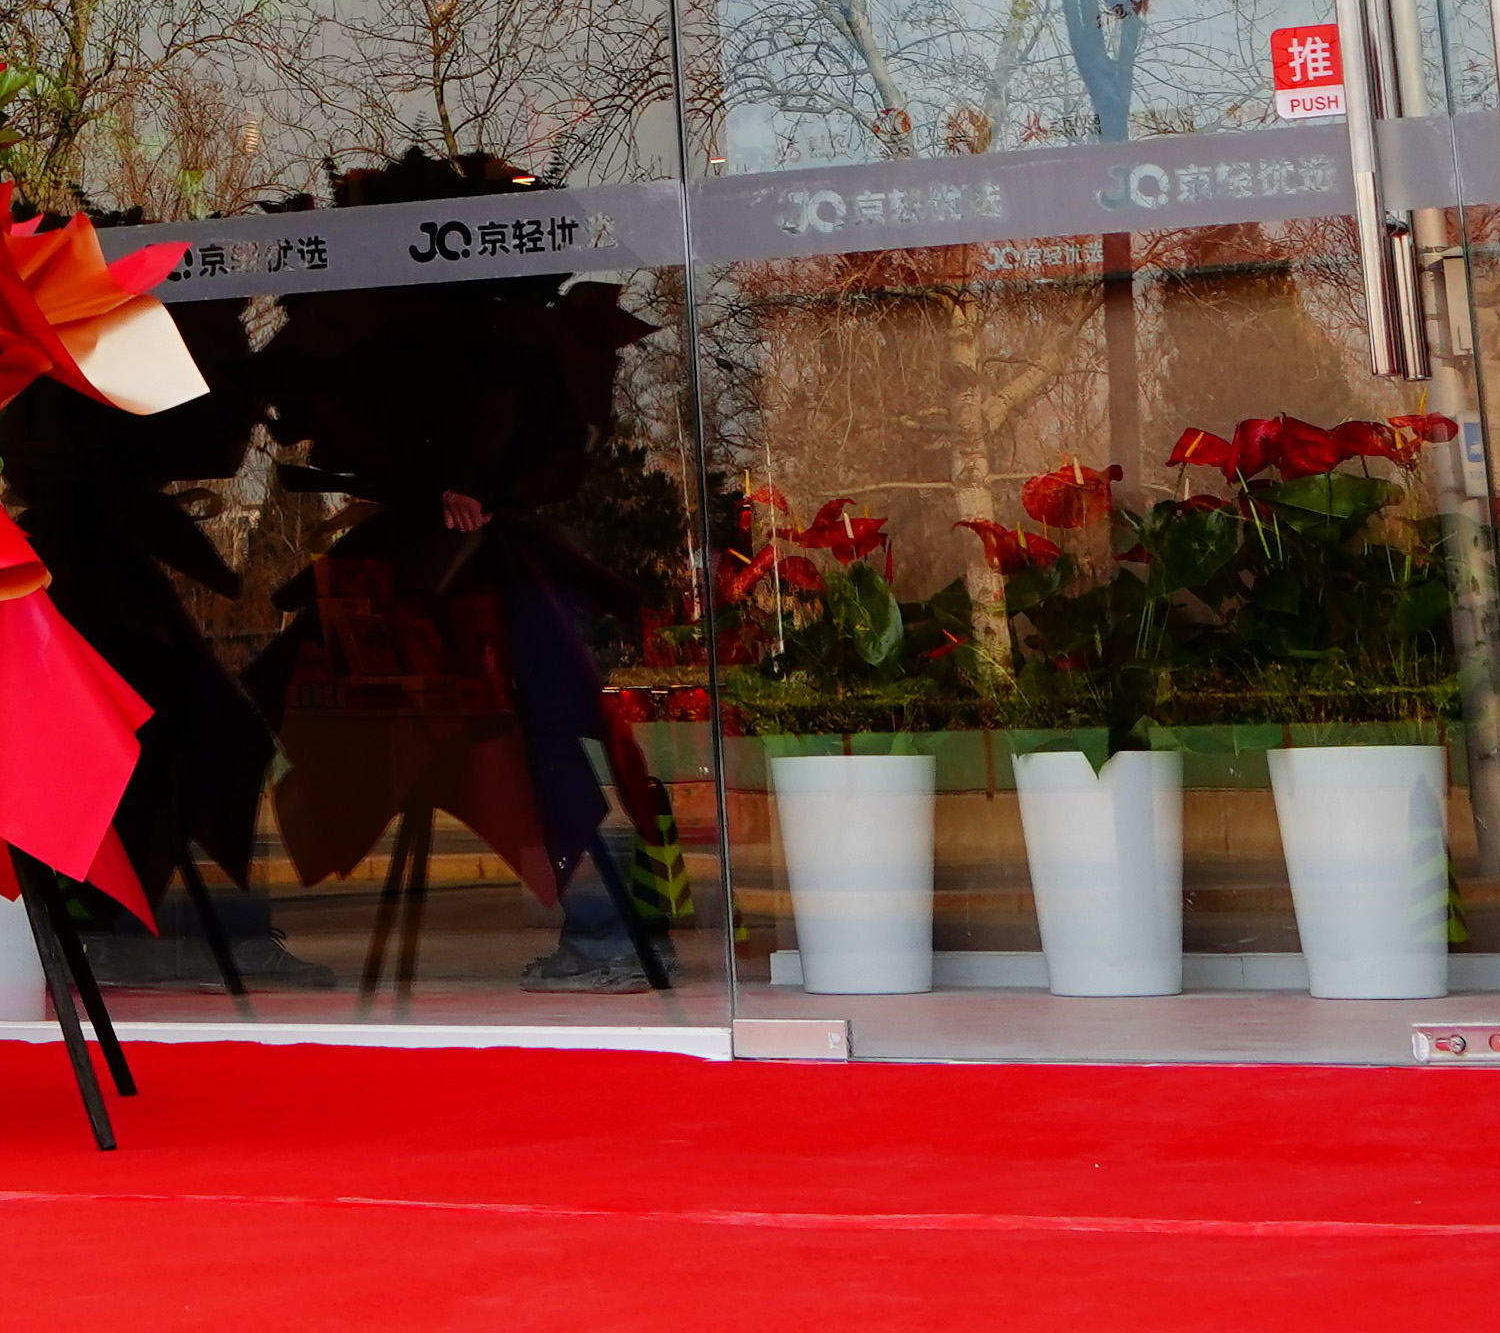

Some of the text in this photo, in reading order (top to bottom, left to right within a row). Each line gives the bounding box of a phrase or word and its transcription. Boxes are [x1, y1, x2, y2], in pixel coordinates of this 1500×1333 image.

[1287, 35, 1333, 82] 推
[1289, 95, 1339, 113] PUSH
[1022, 241, 1104, 267] 京轻优选
